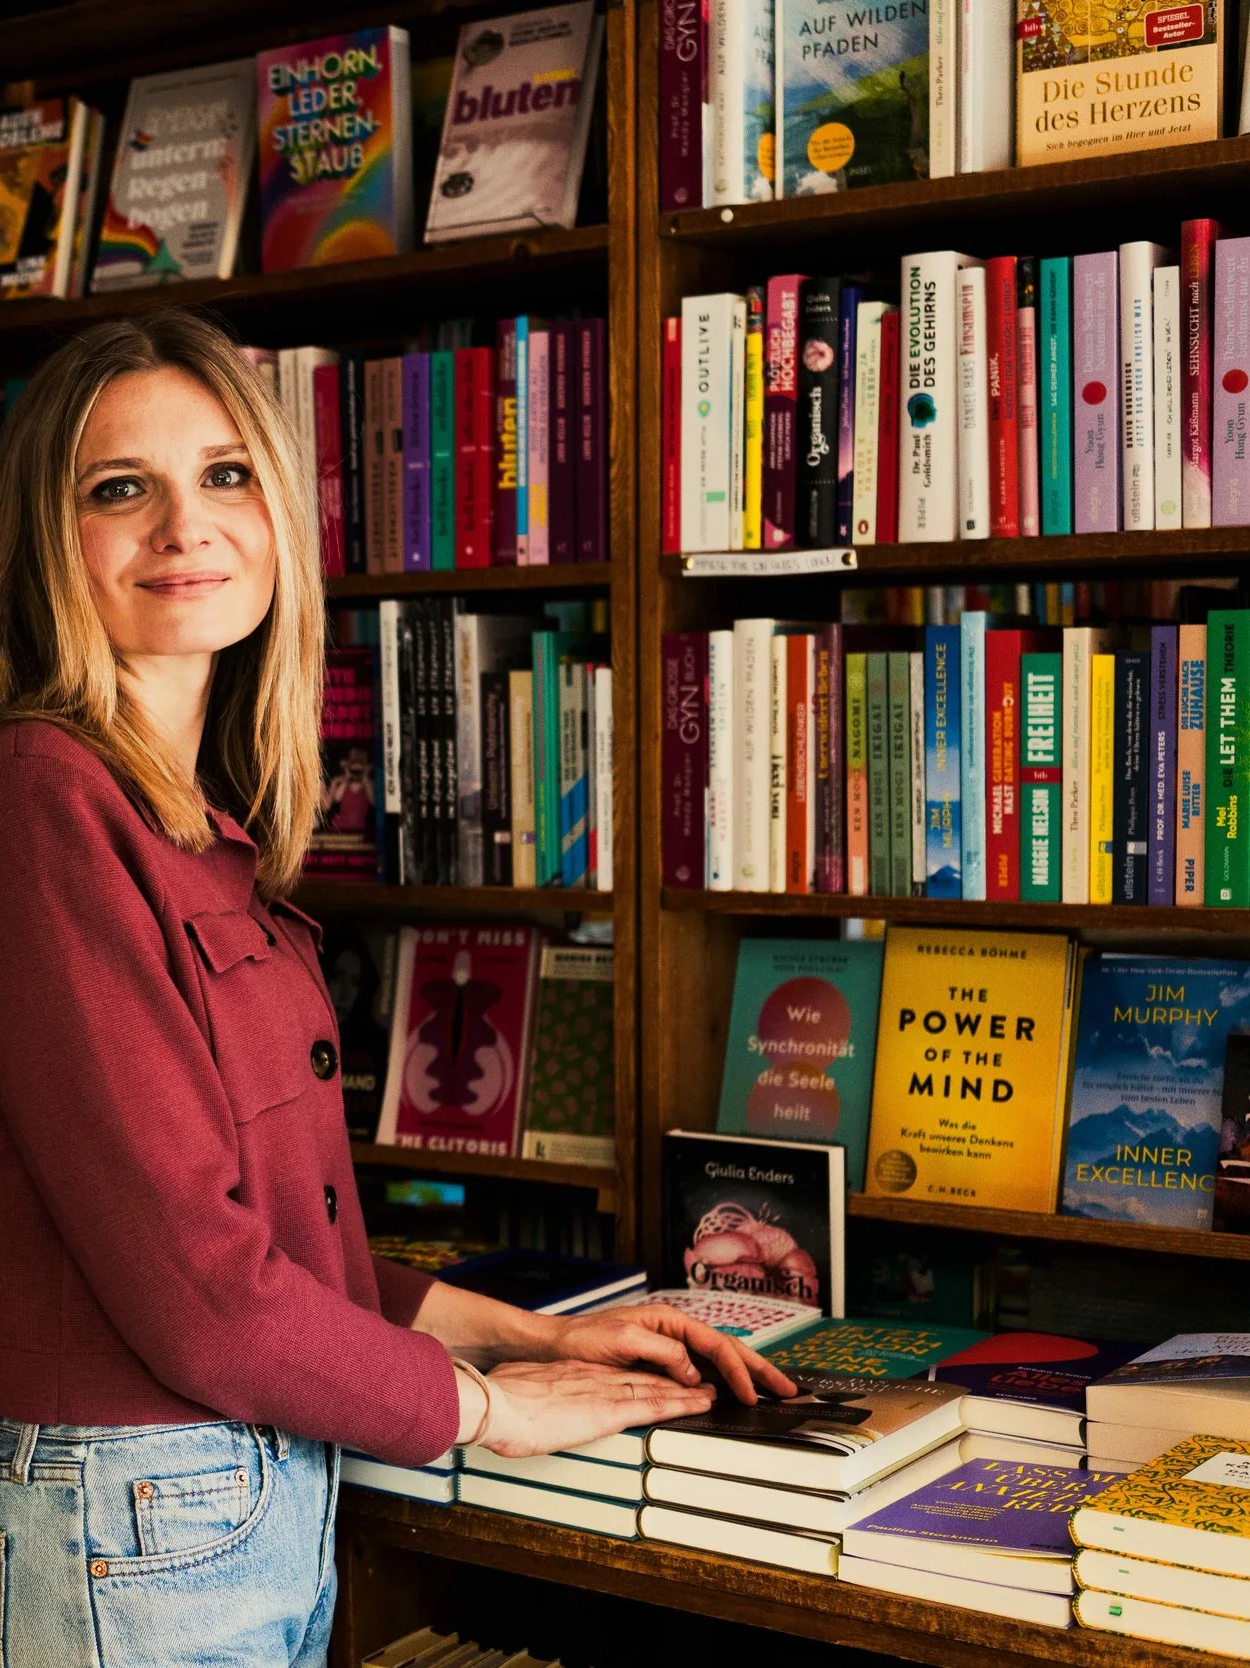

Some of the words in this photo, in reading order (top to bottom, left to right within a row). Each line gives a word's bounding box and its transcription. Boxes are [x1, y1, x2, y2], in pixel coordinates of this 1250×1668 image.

[799, 16, 838, 37] AUF
[846, 0, 928, 27] WILDEN
[1024, 23, 1038, 32] btb
[1153, 20, 1196, 33] Bestseller-
[1157, 11, 1190, 23] SPIEGEL
[676, 2, 697, 62] GYN
[1163, 29, 1185, 39] Autor
[802, 33, 879, 60] PFADEN
[1043, 79, 1085, 103] Die
[1095, 61, 1194, 96] Stunde
[452, 78, 582, 126] bluten
[1035, 110, 1079, 134] des
[1090, 92, 1201, 126] Herzens
[272, 110, 381, 151] STERNEN-
[1045, 141, 1064, 152] Sich
[1067, 135, 1109, 150] begegnen
[1111, 133, 1123, 141] im
[1126, 130, 1145, 140] Hier
[1148, 127, 1166, 137] und
[1167, 124, 1191, 134] Jetzt
[290, 147, 363, 184] STAUB
[1189, 243, 1200, 280] LEBEN
[1189, 281, 1200, 305] nach
[910, 267, 921, 358] EVOLUTION
[924, 282, 936, 352] GEHIRNS
[699, 313, 709, 393] OUTLIVE
[781, 289, 796, 391] HOCHBEGABT
[1189, 307, 1200, 376] SEHNSUCHT
[770, 327, 781, 393] PLÖTZLICH
[924, 357, 936, 388] DES
[910, 364, 921, 389] DIE
[806, 386, 830, 467] Organisch
[1094, 414, 1106, 441] Gyun
[1189, 392, 1200, 437] Käßmann
[1235, 403, 1246, 430] Gyun
[1084, 430, 1095, 454] Yoon
[1224, 419, 1235, 444] Yoon
[1094, 443, 1106, 469] Hong
[1189, 438, 1202, 470] Margot
[1235, 432, 1246, 460] Hong
[1130, 478, 1141, 522] ullstein
[1223, 624, 1235, 673] THEORIE
[936, 643, 947, 727] EXCELLENCE
[1181, 661, 1189, 684] NACH
[1181, 686, 1189, 714] SUCHE
[1190, 660, 1204, 730] ZUHAUSE
[1220, 677, 1236, 728] THEM
[679, 685, 700, 744] GYN
[852, 698, 861, 759] NAGOMI
[1027, 672, 1054, 761] FREIHEIT
[1181, 715, 1189, 729] DIE
[872, 704, 882, 759] IKIGAI
[894, 704, 903, 759] IKIGAI
[1157, 731, 1165, 761] PETERS
[1220, 733, 1236, 765] LET
[1157, 763, 1165, 778] EVA
[1182, 771, 1190, 796] LUISE
[1223, 767, 1233, 787] DIE
[1004, 784, 1013, 814] NAST
[1070, 780, 1079, 809] Parker
[1157, 780, 1165, 799] MED.
[1192, 784, 1201, 817] RITTER
[930, 808, 940, 830] JIM
[993, 784, 1003, 834] MICHAEL
[1032, 789, 1049, 836] NELSON
[1070, 810, 1079, 832] Theo
[1157, 801, 1165, 815] DR.
[1182, 798, 1190, 829] MARIE
[1216, 806, 1226, 827] Mel
[1226, 795, 1238, 839] Robbins
[1157, 817, 1165, 840] PROF.
[1032, 838, 1049, 885] MAGGIE
[1185, 858, 1194, 892] PIPER
[1124, 856, 1134, 899] ullstein
[918, 945, 974, 957] REBECCA
[981, 946, 1028, 960] BÖHME
[949, 986, 988, 1002] THE
[1145, 984, 1185, 1003] JIM
[787, 1005, 821, 1024] Wie
[899, 1008, 1036, 1042] POWER
[1113, 1006, 1219, 1027] MURPHY
[747, 1035, 855, 1059] Synchronität
[924, 1048, 953, 1063] OF
[963, 1051, 1003, 1067] THE
[757, 1073, 783, 1087] die
[788, 1072, 835, 1091] Seele
[908, 1073, 1014, 1103] MIND
[773, 1104, 811, 1122] heilt
[939, 1118, 959, 1130] Was
[962, 1120, 977, 1131] die
[901, 1128, 926, 1140] Kraft
[929, 1133, 966, 1144] unseres
[970, 1134, 1014, 1149] Denkens
[919, 1143, 963, 1158] bewirken
[966, 1147, 992, 1160] kann
[1115, 1145, 1192, 1167] INNER
[705, 1161, 746, 1181] Giulia
[748, 1166, 795, 1186] Enders
[1076, 1163, 1215, 1193] EXCELLENC
[690, 1261, 813, 1299] Organisch
[771, 1350, 889, 1364] MEINE
[984, 1461, 1073, 1479] LASS
[995, 1473, 1087, 1492] ÜBER
[867, 1523, 916, 1535] Pauline
[919, 1527, 999, 1544] Stockmann
